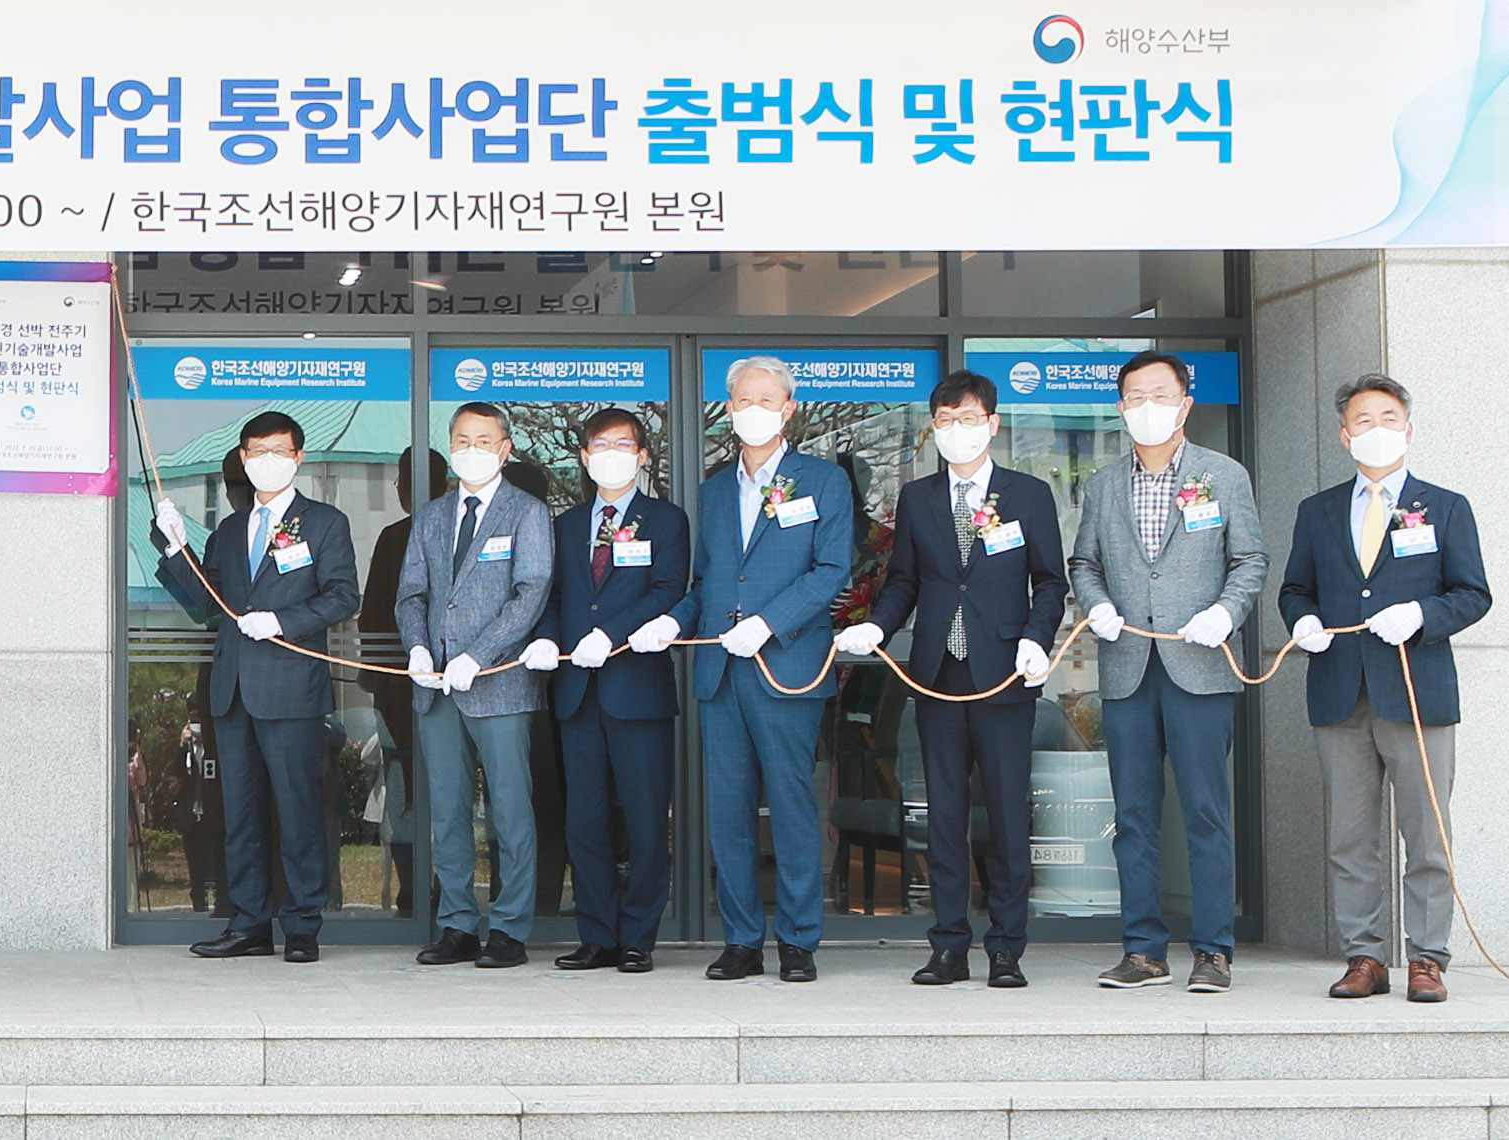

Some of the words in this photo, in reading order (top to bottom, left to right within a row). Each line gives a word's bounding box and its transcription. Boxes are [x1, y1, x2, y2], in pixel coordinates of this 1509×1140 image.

[1106, 29, 1230, 54] 해양수산부
[209, 77, 618, 165] 통합사업단
[638, 78, 873, 164] 출범식
[903, 79, 975, 164] 및
[1001, 79, 1232, 163] 현판식
[131, 191, 628, 232] 한국조선해양기자재연구원
[647, 191, 724, 231] 본원
[18, 324, 43, 337] 선박
[48, 325, 86, 338] 전주기
[211, 360, 366, 377] 한국조선해양기자재연구원
[491, 361, 644, 378] 한국조선해양기자재연구원
[784, 362, 915, 378] 조선해양기자재연구원
[23, 382, 35, 395] 및
[40, 382, 79, 396] 현판식
[211, 378, 233, 386] Korea
[235, 378, 259, 386] Marine
[261, 378, 299, 388] Equipment
[301, 378, 334, 386] Research
[336, 378, 366, 386] Institute
[492, 379, 513, 387] Korea
[515, 379, 539, 387] Marine
[541, 379, 578, 389] Equipment
[580, 379, 613, 387] Research
[615, 379, 644, 387] Institute
[812, 379, 850, 389] Equipment
[852, 379, 884, 387] Research
[886, 380, 915, 388] Institute
[1045, 382, 1067, 390] Korea
[1068, 382, 1092, 390] Marine
